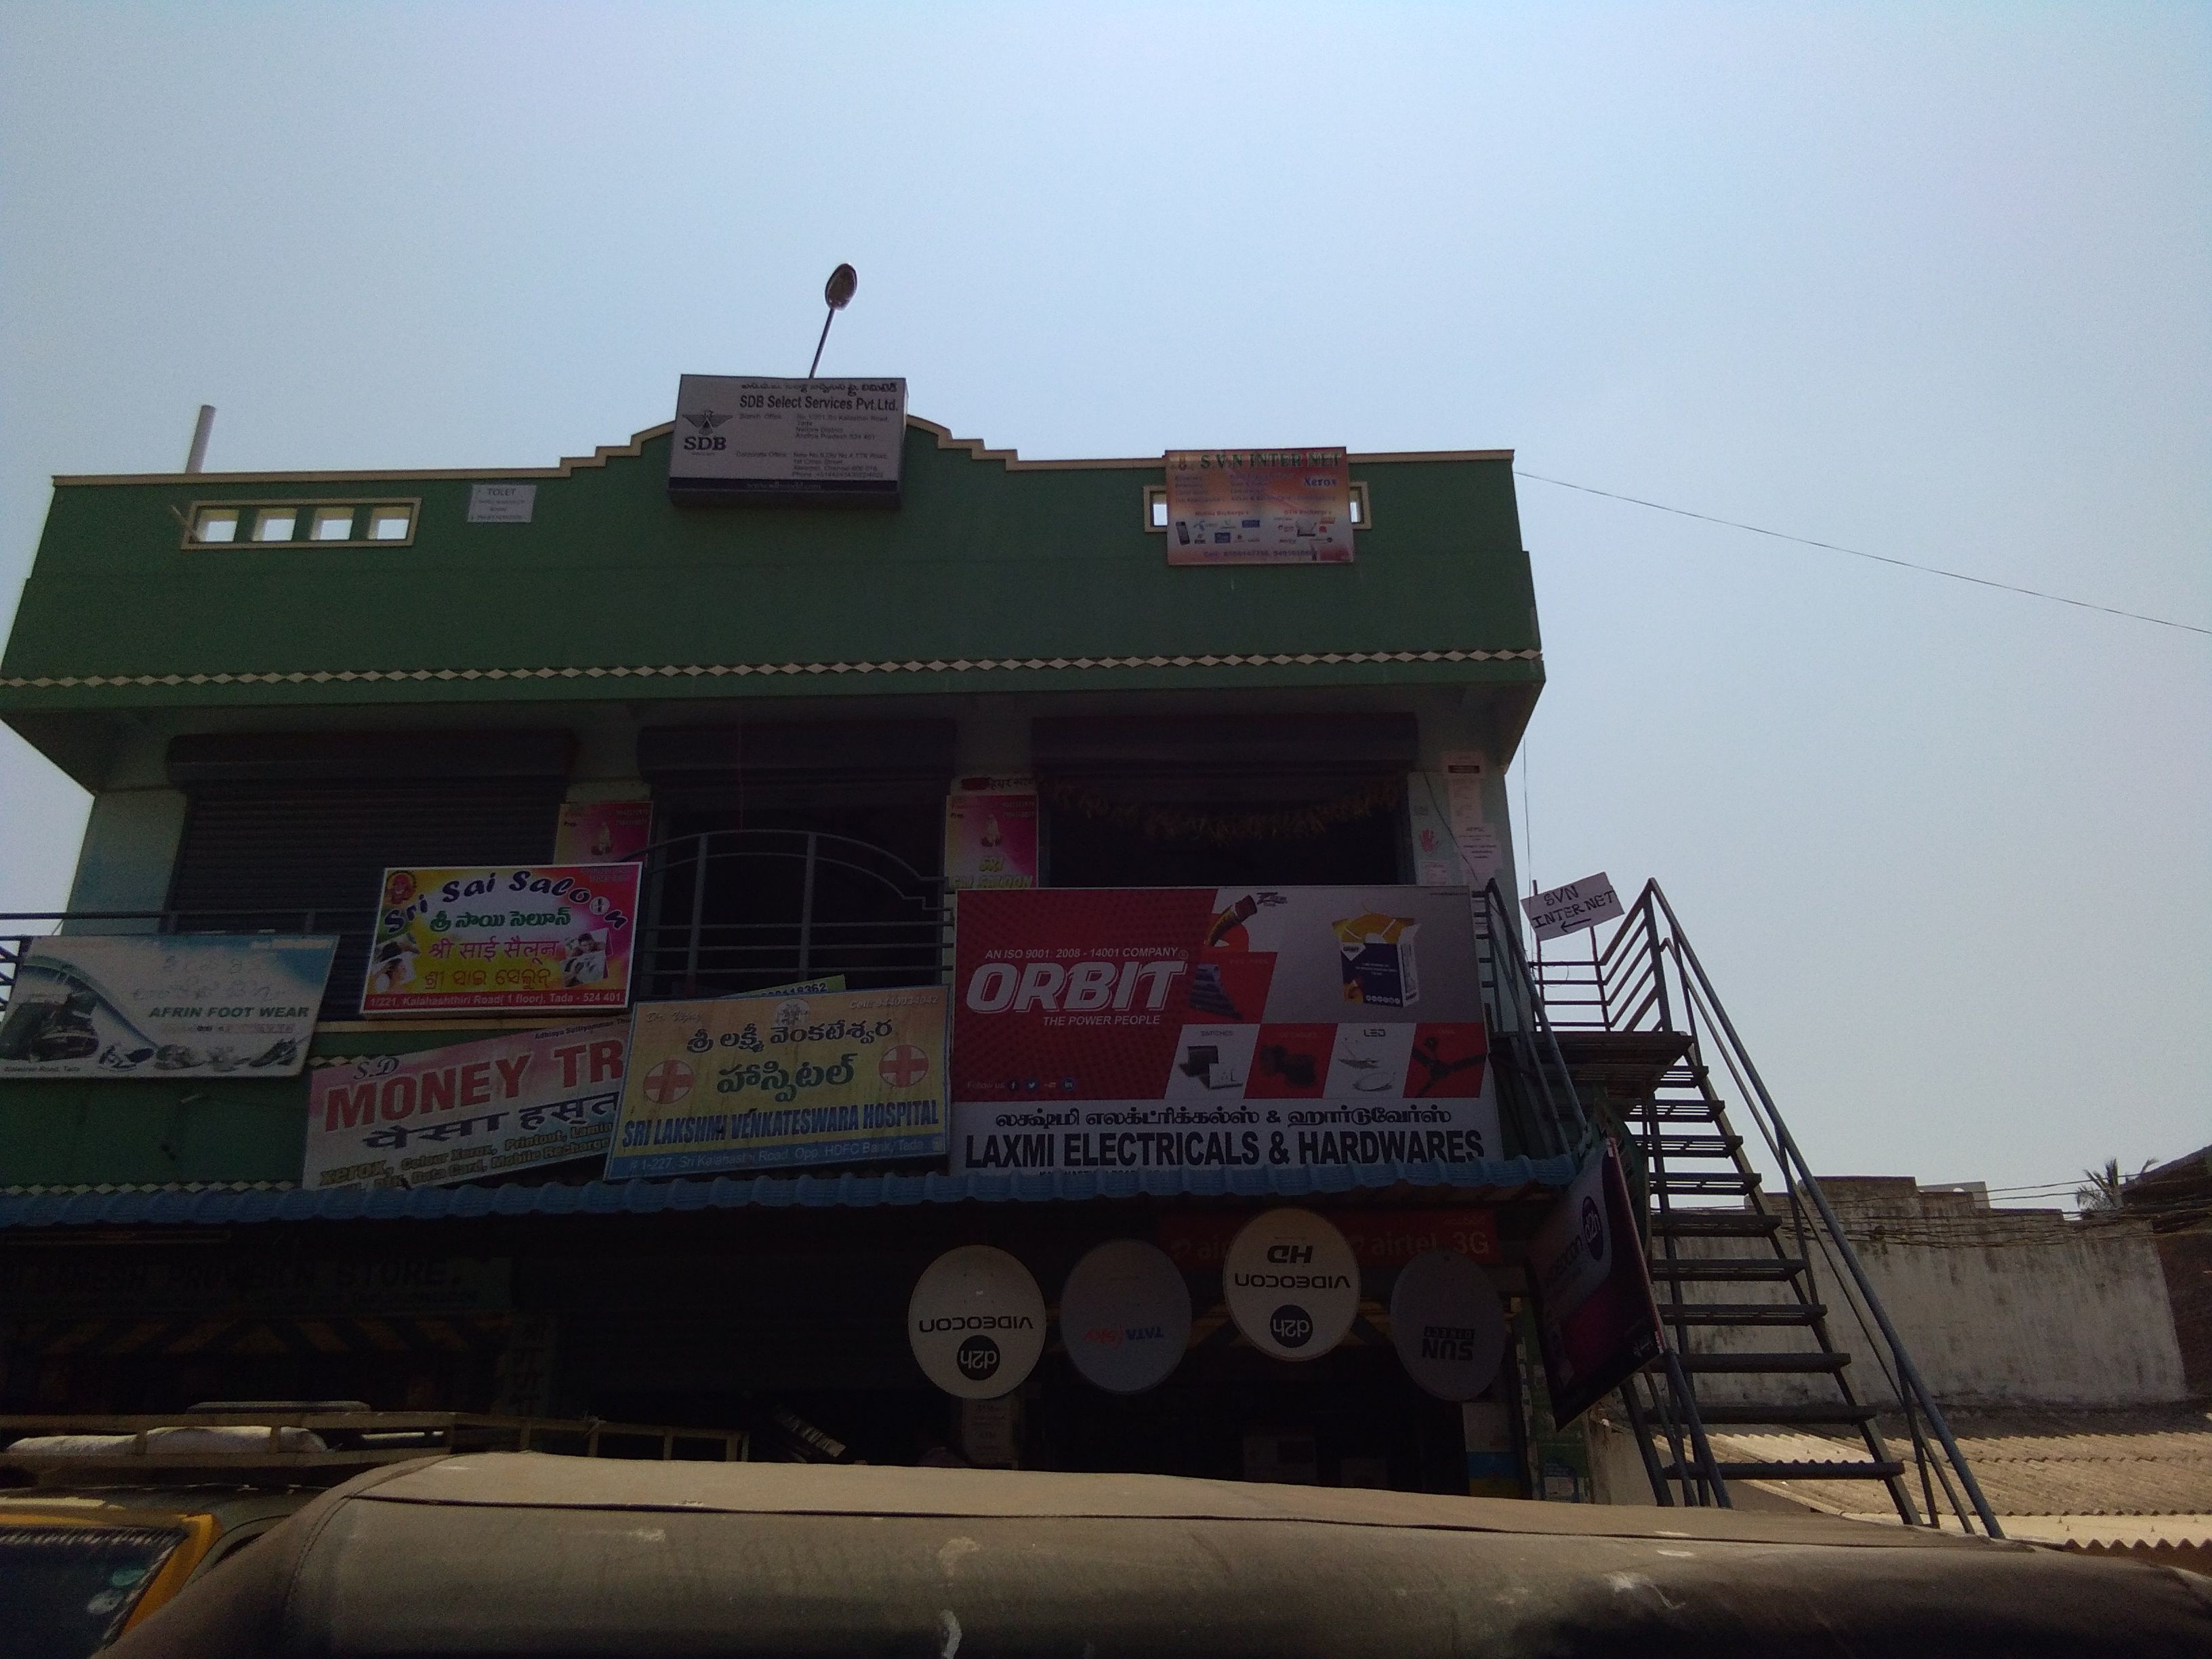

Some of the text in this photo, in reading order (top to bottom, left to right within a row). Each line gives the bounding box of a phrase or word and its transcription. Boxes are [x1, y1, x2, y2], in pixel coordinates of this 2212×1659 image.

[739, 395, 764, 408] SDB
[767, 395, 802, 409] Select
[804, 396, 853, 410] Services
[684, 436, 727, 451] SDB
[384, 894, 428, 933] Sri
[442, 872, 496, 903] Sai
[1544, 885, 1579, 907] SVN
[1532, 890, 1616, 928] INTER NET
[430, 909, 452, 933] శ్రీ
[455, 912, 506, 928] సాయి
[428, 935, 560, 966] श्री साई सैलून
[985, 948, 1001, 959] AN
[1004, 948, 1024, 959] ISO
[1056, 947, 1080, 958] 2008
[1090, 947, 1120, 958] 14001
[1122, 947, 1179, 958] COMPANY
[965, 959, 1189, 1015] ORBIT
[550, 994, 573, 1002] Tada
[583, 993, 601, 1002] 524
[148, 1006, 309, 1018] AFRIN FOOT WEAR
[1042, 1015, 1161, 1026] THE POWER PEOPLE
[687, 1029, 715, 1054] శ్రీ
[1364, 1029, 1387, 1038] LED
[325, 1052, 532, 1132] MONEY
[966, 1081, 994, 1090] Follow
[622, 1099, 939, 1148] SRI LAKSHMI VENKATESWARA HOSPITAL
[1266, 1109, 1282, 1124] &
[758, 1150, 788, 1163] Road
[794, 1147, 819, 1162] Opp
[824, 1145, 860, 1158] HDFC
[964, 1128, 1484, 1168] LAXMI ELECTRICALS & HARDWARES
[1452, 1231, 1490, 1256] 3G
[1267, 1245, 1313, 1265] HD
[1124, 1326, 1164, 1341] TATA
[1272, 1318, 1310, 1338] d2h
[960, 1349, 997, 1370] d2h
[1421, 1338, 1474, 1361] SUN
